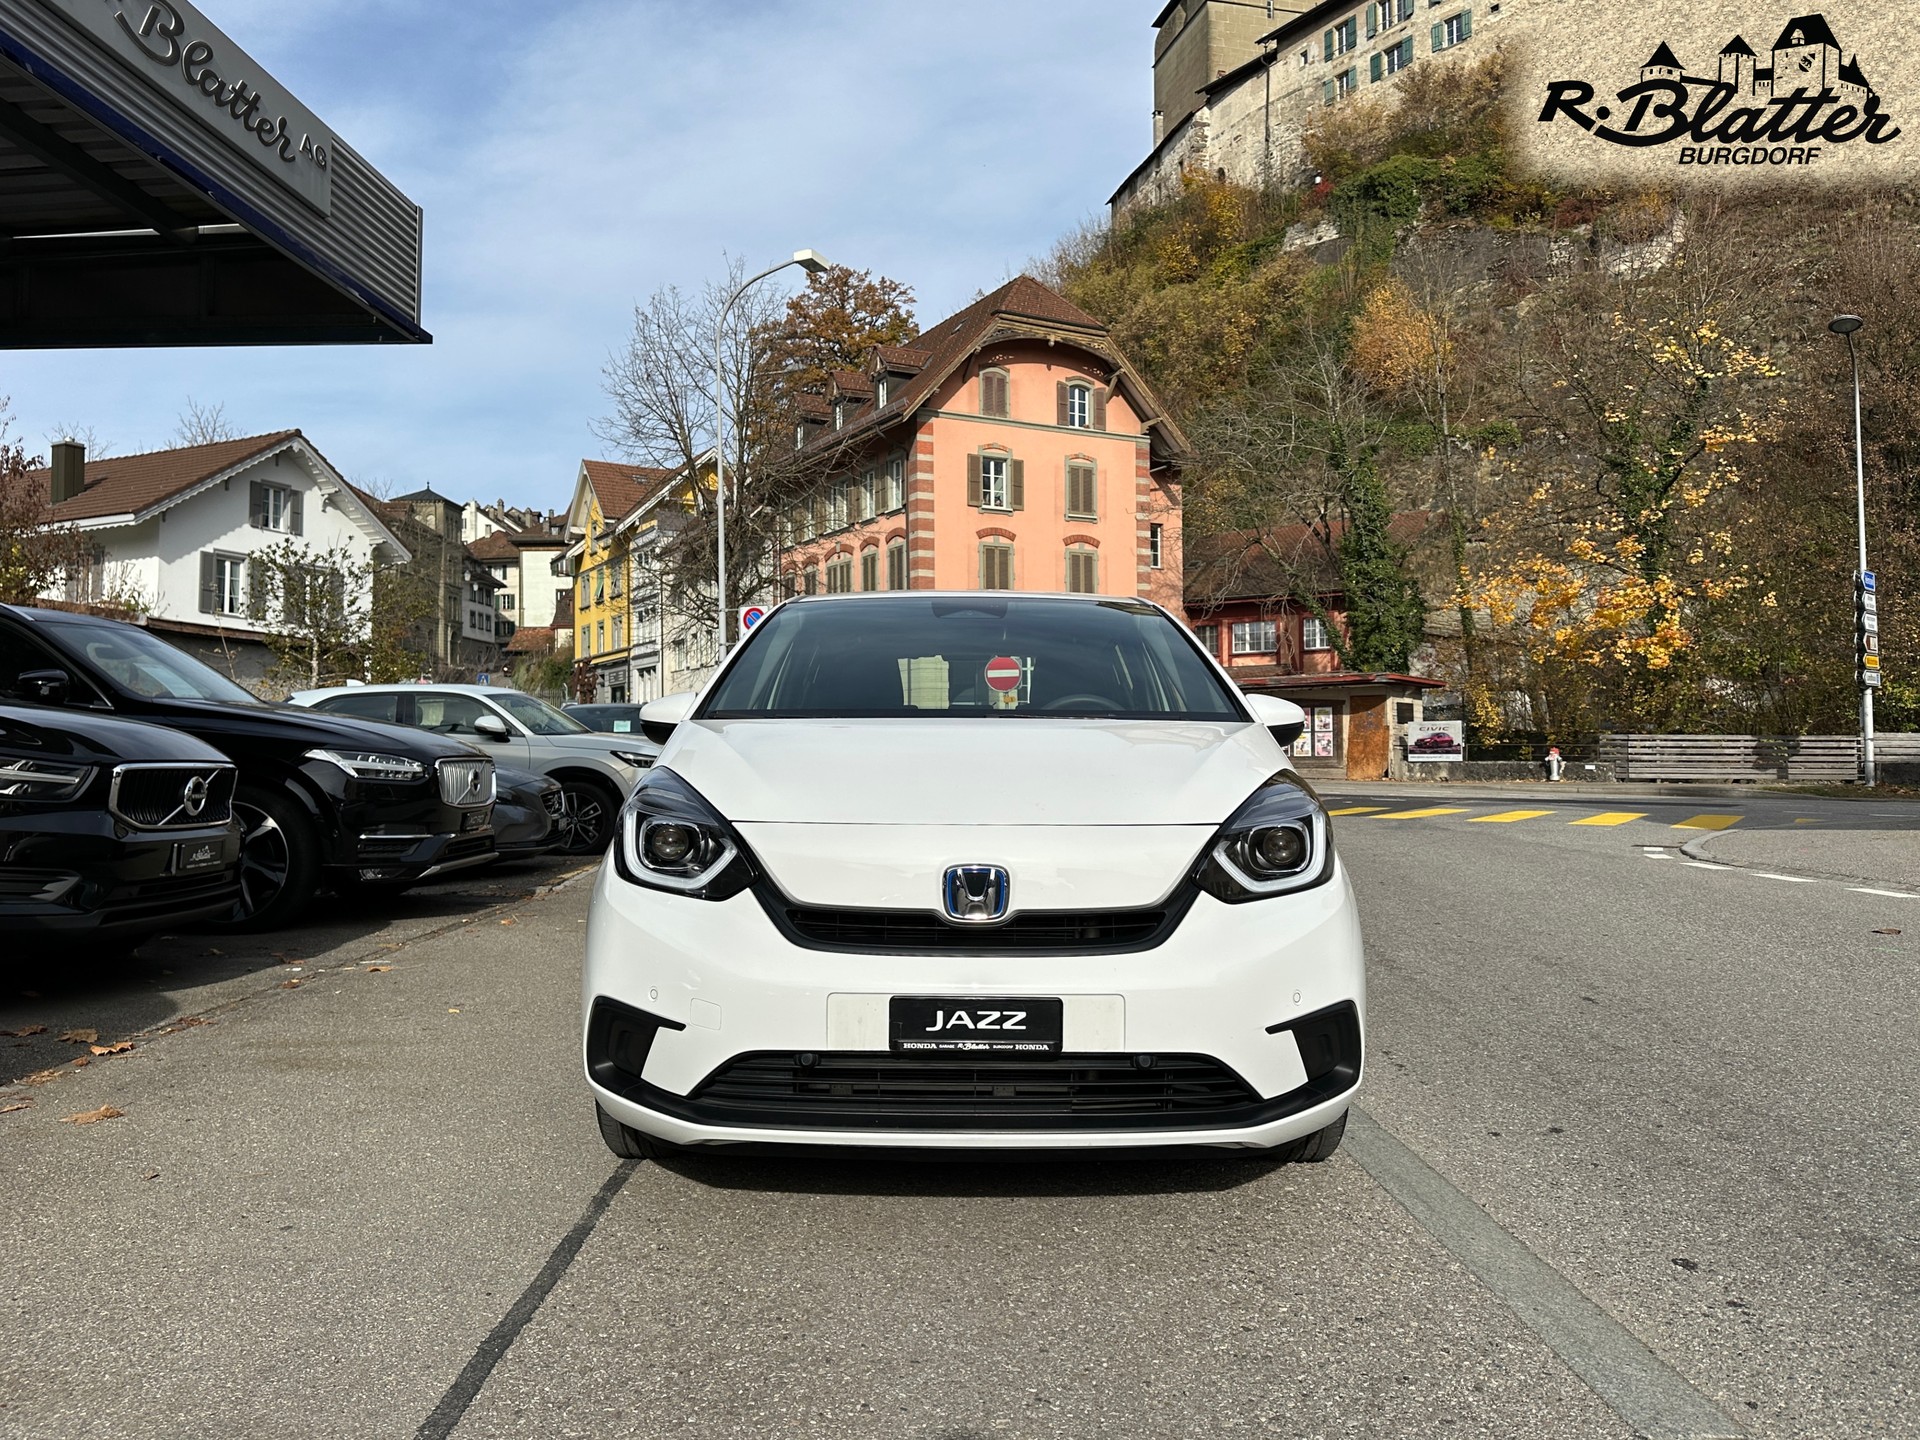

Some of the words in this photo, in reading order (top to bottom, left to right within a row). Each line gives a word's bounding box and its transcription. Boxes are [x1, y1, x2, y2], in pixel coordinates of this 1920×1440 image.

[114, 0, 296, 163] Blatter
[299, 133, 327, 171] AG
[925, 1010, 1027, 1032] JAZZ
